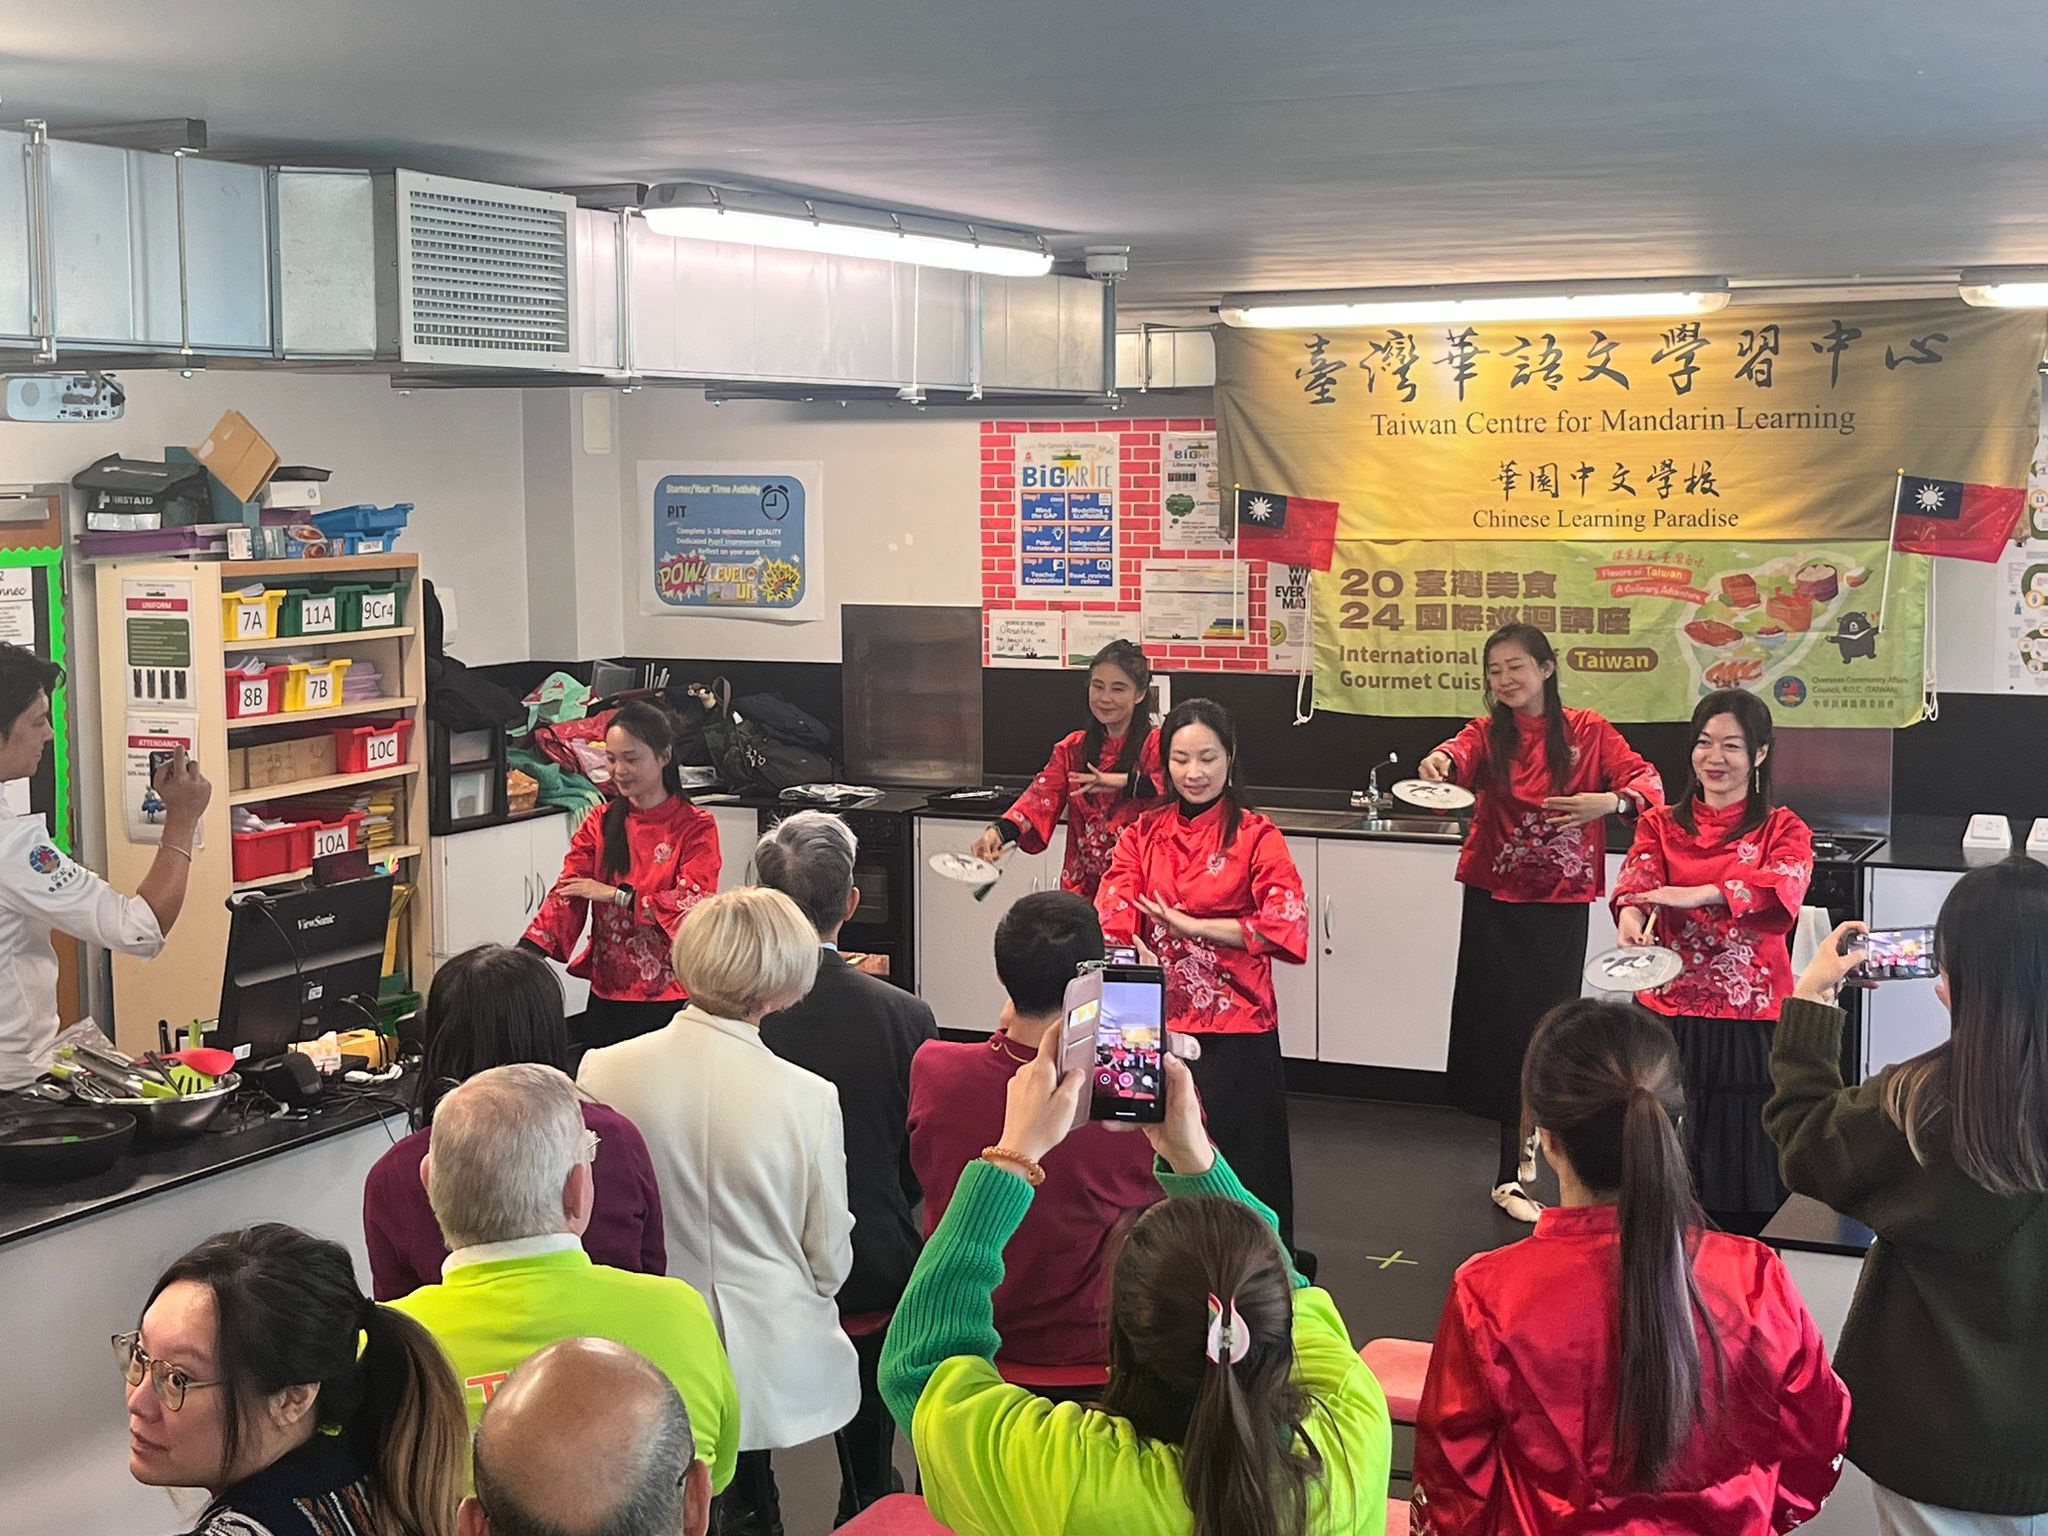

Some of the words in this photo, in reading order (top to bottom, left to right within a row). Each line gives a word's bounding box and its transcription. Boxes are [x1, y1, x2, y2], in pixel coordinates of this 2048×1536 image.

[1296, 319, 1948, 404] 臺灣華語文學習中心
[1370, 412, 1457, 436] Taiwan
[1466, 411, 1547, 434] Centre
[1557, 409, 1593, 433] for
[1600, 407, 1725, 432] Mandarin
[1735, 404, 1856, 435] Learning
[1492, 458, 1720, 501] 華園中文學校
[712, 484, 731, 494] Time
[732, 484, 760, 496] Activity
[667, 505, 687, 518] PIT
[1473, 509, 1550, 528] Chinese
[1557, 508, 1645, 532] Learning
[1653, 508, 1739, 528] Paradise
[676, 528, 706, 536] Complete
[676, 537, 707, 545] Dedicated
[766, 538, 781, 546] Time
[707, 567, 747, 582] LEVEL
[1601, 568, 1632, 578] Flavors
[1645, 566, 1683, 579] Taiwan
[1339, 568, 1404, 599] 20
[1414, 569, 1557, 599] 臺灣美食
[1616, 585, 1623, 593] A
[1625, 584, 1659, 595] Culinary
[1660, 585, 1701, 600] Adventure
[141, 601, 172, 609] UNIFORM
[364, 601, 394, 620] 9Cr4
[242, 611, 262, 631] 7A
[304, 605, 332, 625] 11A
[1339, 601, 1405, 631] 24
[1339, 644, 1478, 666] International
[1573, 650, 1650, 670] Taiwan
[310, 680, 328, 699] 7B
[1339, 671, 1433, 690] Gourmet
[1812, 686, 1841, 694] Council,
[1865, 685, 1898, 694] (TAIWAN)
[1847, 676, 1886, 684] Community
[244, 687, 263, 707] 8B
[369, 739, 396, 761] 10C
[317, 833, 346, 855] 10A
[297, 913, 336, 930] ViewSonic
